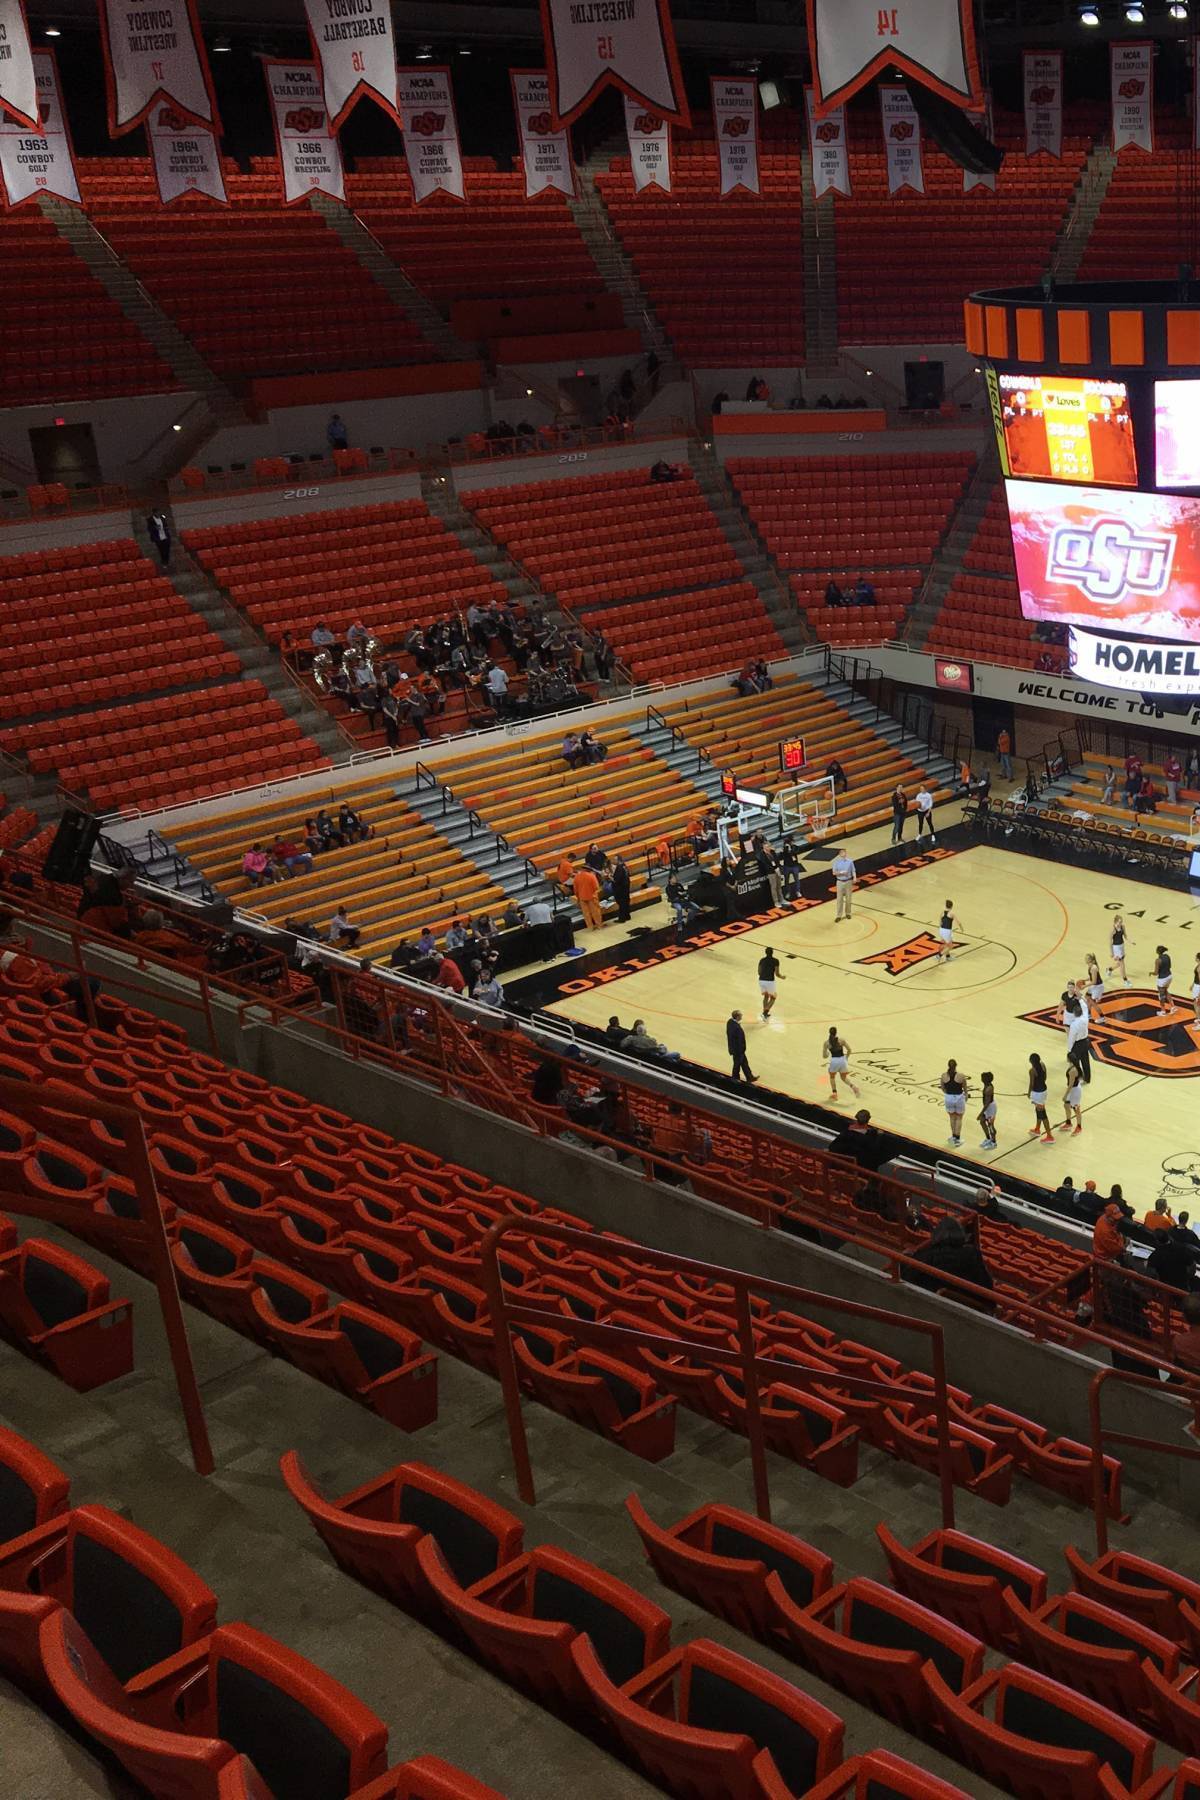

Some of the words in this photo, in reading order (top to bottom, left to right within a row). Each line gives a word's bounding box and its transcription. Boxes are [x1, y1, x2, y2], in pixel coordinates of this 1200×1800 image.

[285, 73, 312, 82] NCAA
[410, 79, 434, 88] NCAA
[274, 86, 320, 96] CHAMPION
[18, 139, 48, 150] 1963
[171, 141, 199, 152] 1964
[297, 143, 321, 153] 1966
[538, 144, 556, 153] 1971
[17, 154, 54, 164] COWBOY
[170, 156, 204, 164] COWBOY
[295, 157, 327, 165] COWBOY
[420, 158, 448, 166] COWBOY
[29, 165, 47, 173] GOLF
[987, 374, 1003, 437] Hertz
[838, 432, 864, 441] 210
[558, 452, 588, 464] 209
[284, 487, 319, 500] 208
[1047, 515, 1175, 604] OSU
[1018, 681, 1118, 710] WELCOME
[785, 750, 800, 768] 30
[558, 897, 827, 996] OKLAHOMA
[862, 1074, 916, 1096] SUTTON
[918, 1094, 946, 1107] COU
